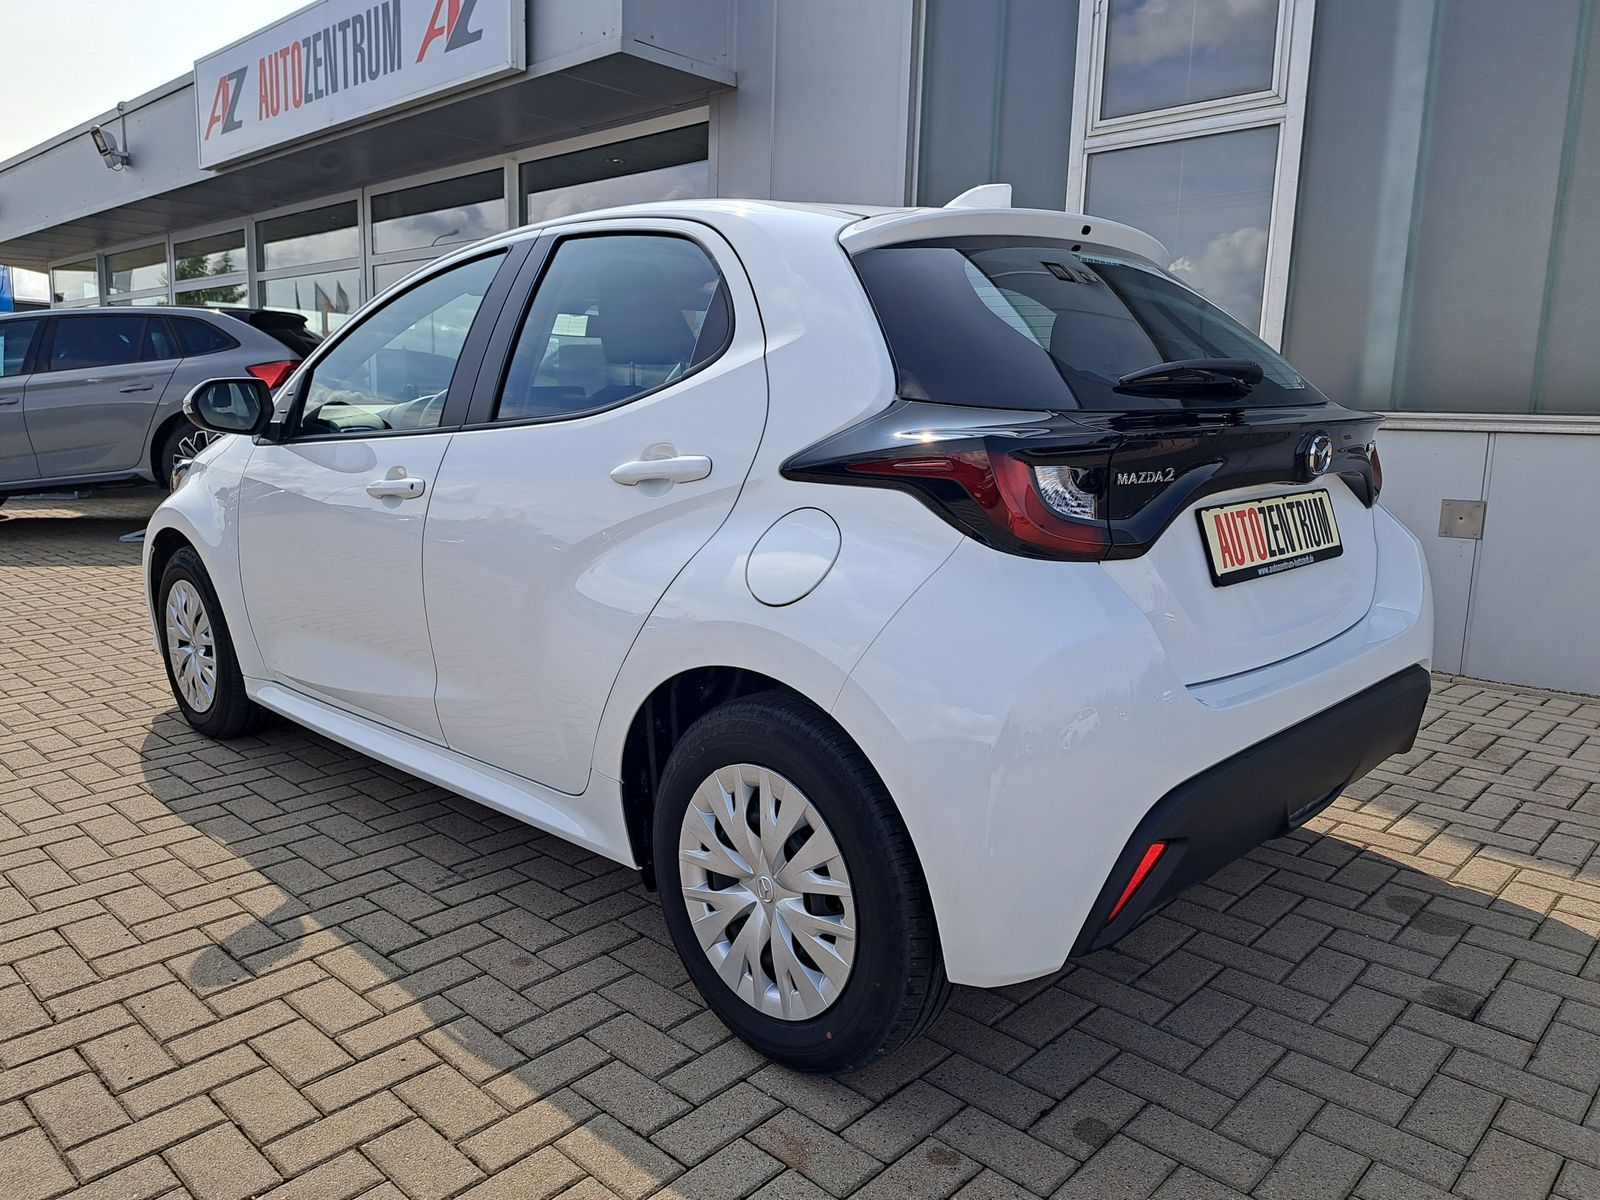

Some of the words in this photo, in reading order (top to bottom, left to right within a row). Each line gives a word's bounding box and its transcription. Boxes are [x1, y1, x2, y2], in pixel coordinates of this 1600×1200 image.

[204, 65, 248, 141] AZ
[258, 1, 402, 121] AUTOZENTRUM
[1117, 467, 1175, 485] MAZDA2
[1213, 497, 1334, 569] AUTOZENTRUM
